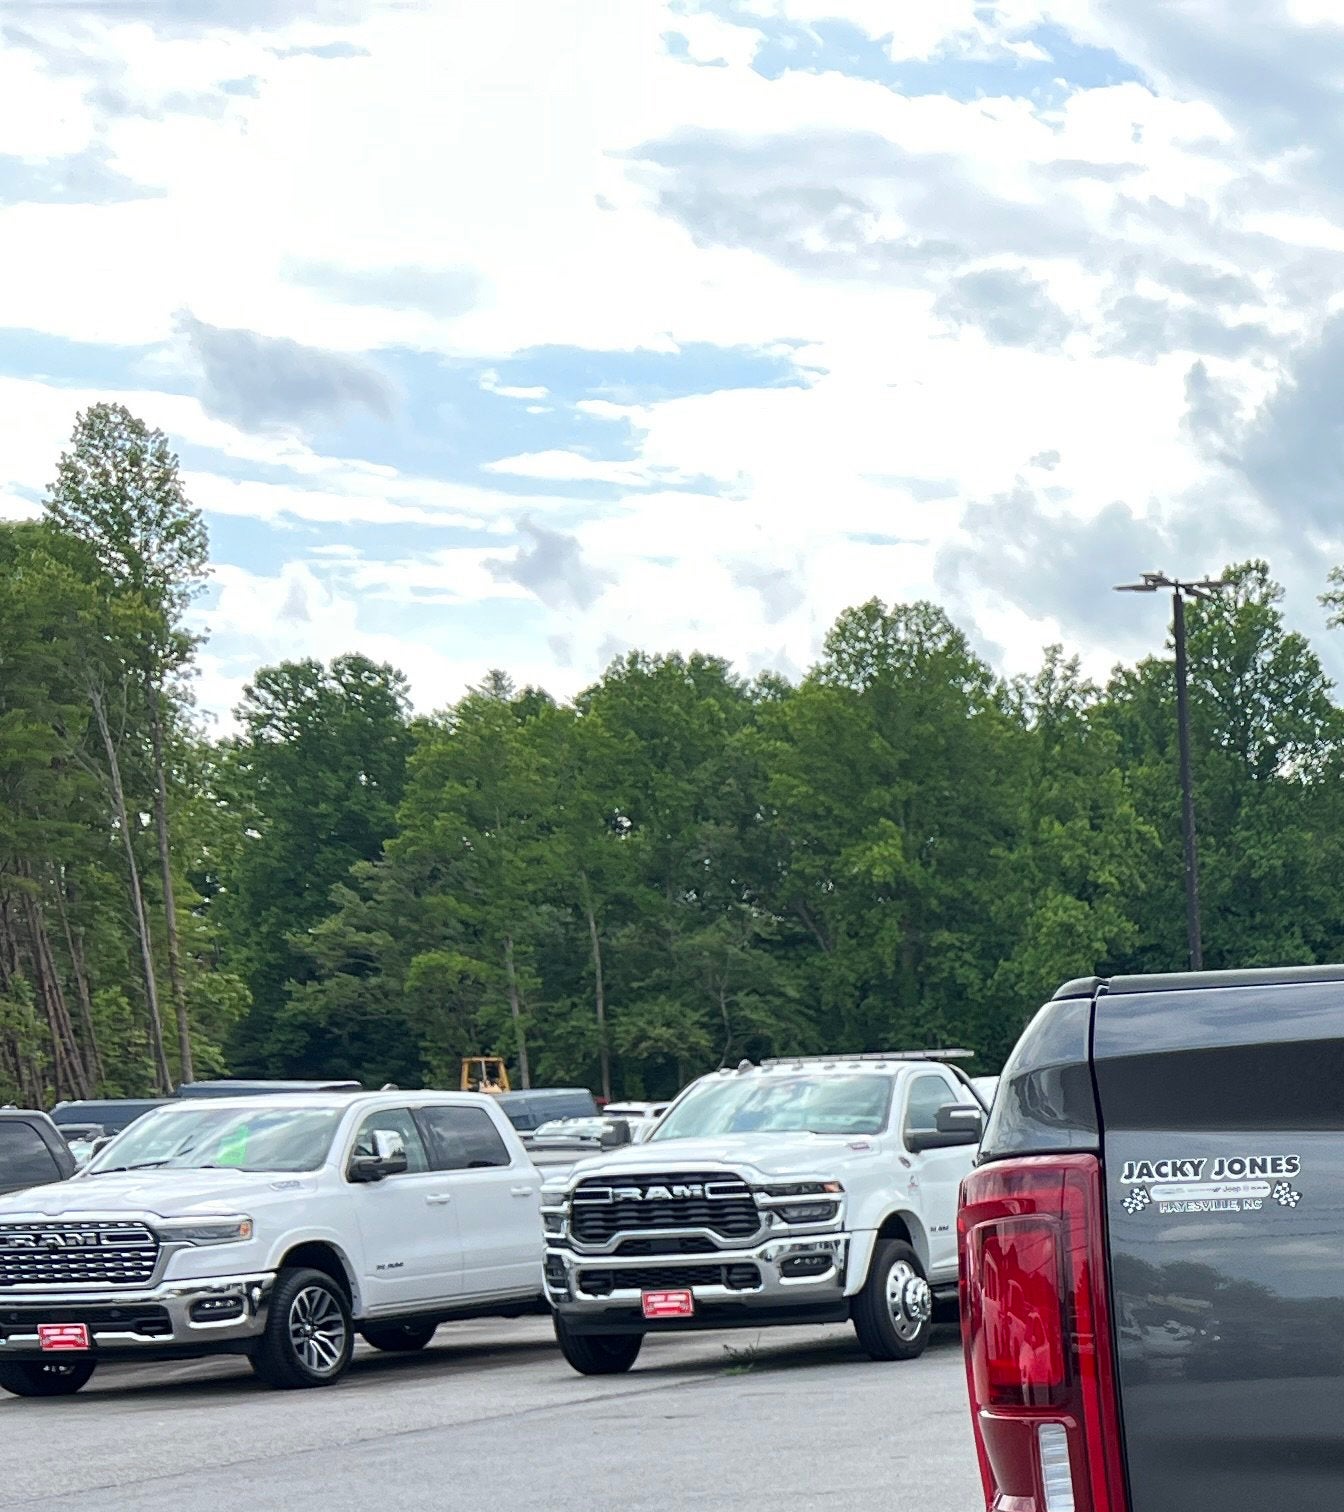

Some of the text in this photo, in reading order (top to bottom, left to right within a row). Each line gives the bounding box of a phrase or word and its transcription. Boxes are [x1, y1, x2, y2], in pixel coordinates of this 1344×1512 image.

[1122, 1155, 1301, 1182] JACKY JONES
[612, 1184, 703, 1200] RAM
[1243, 1198, 1263, 1210] NC
[7, 1232, 98, 1248] RAM
